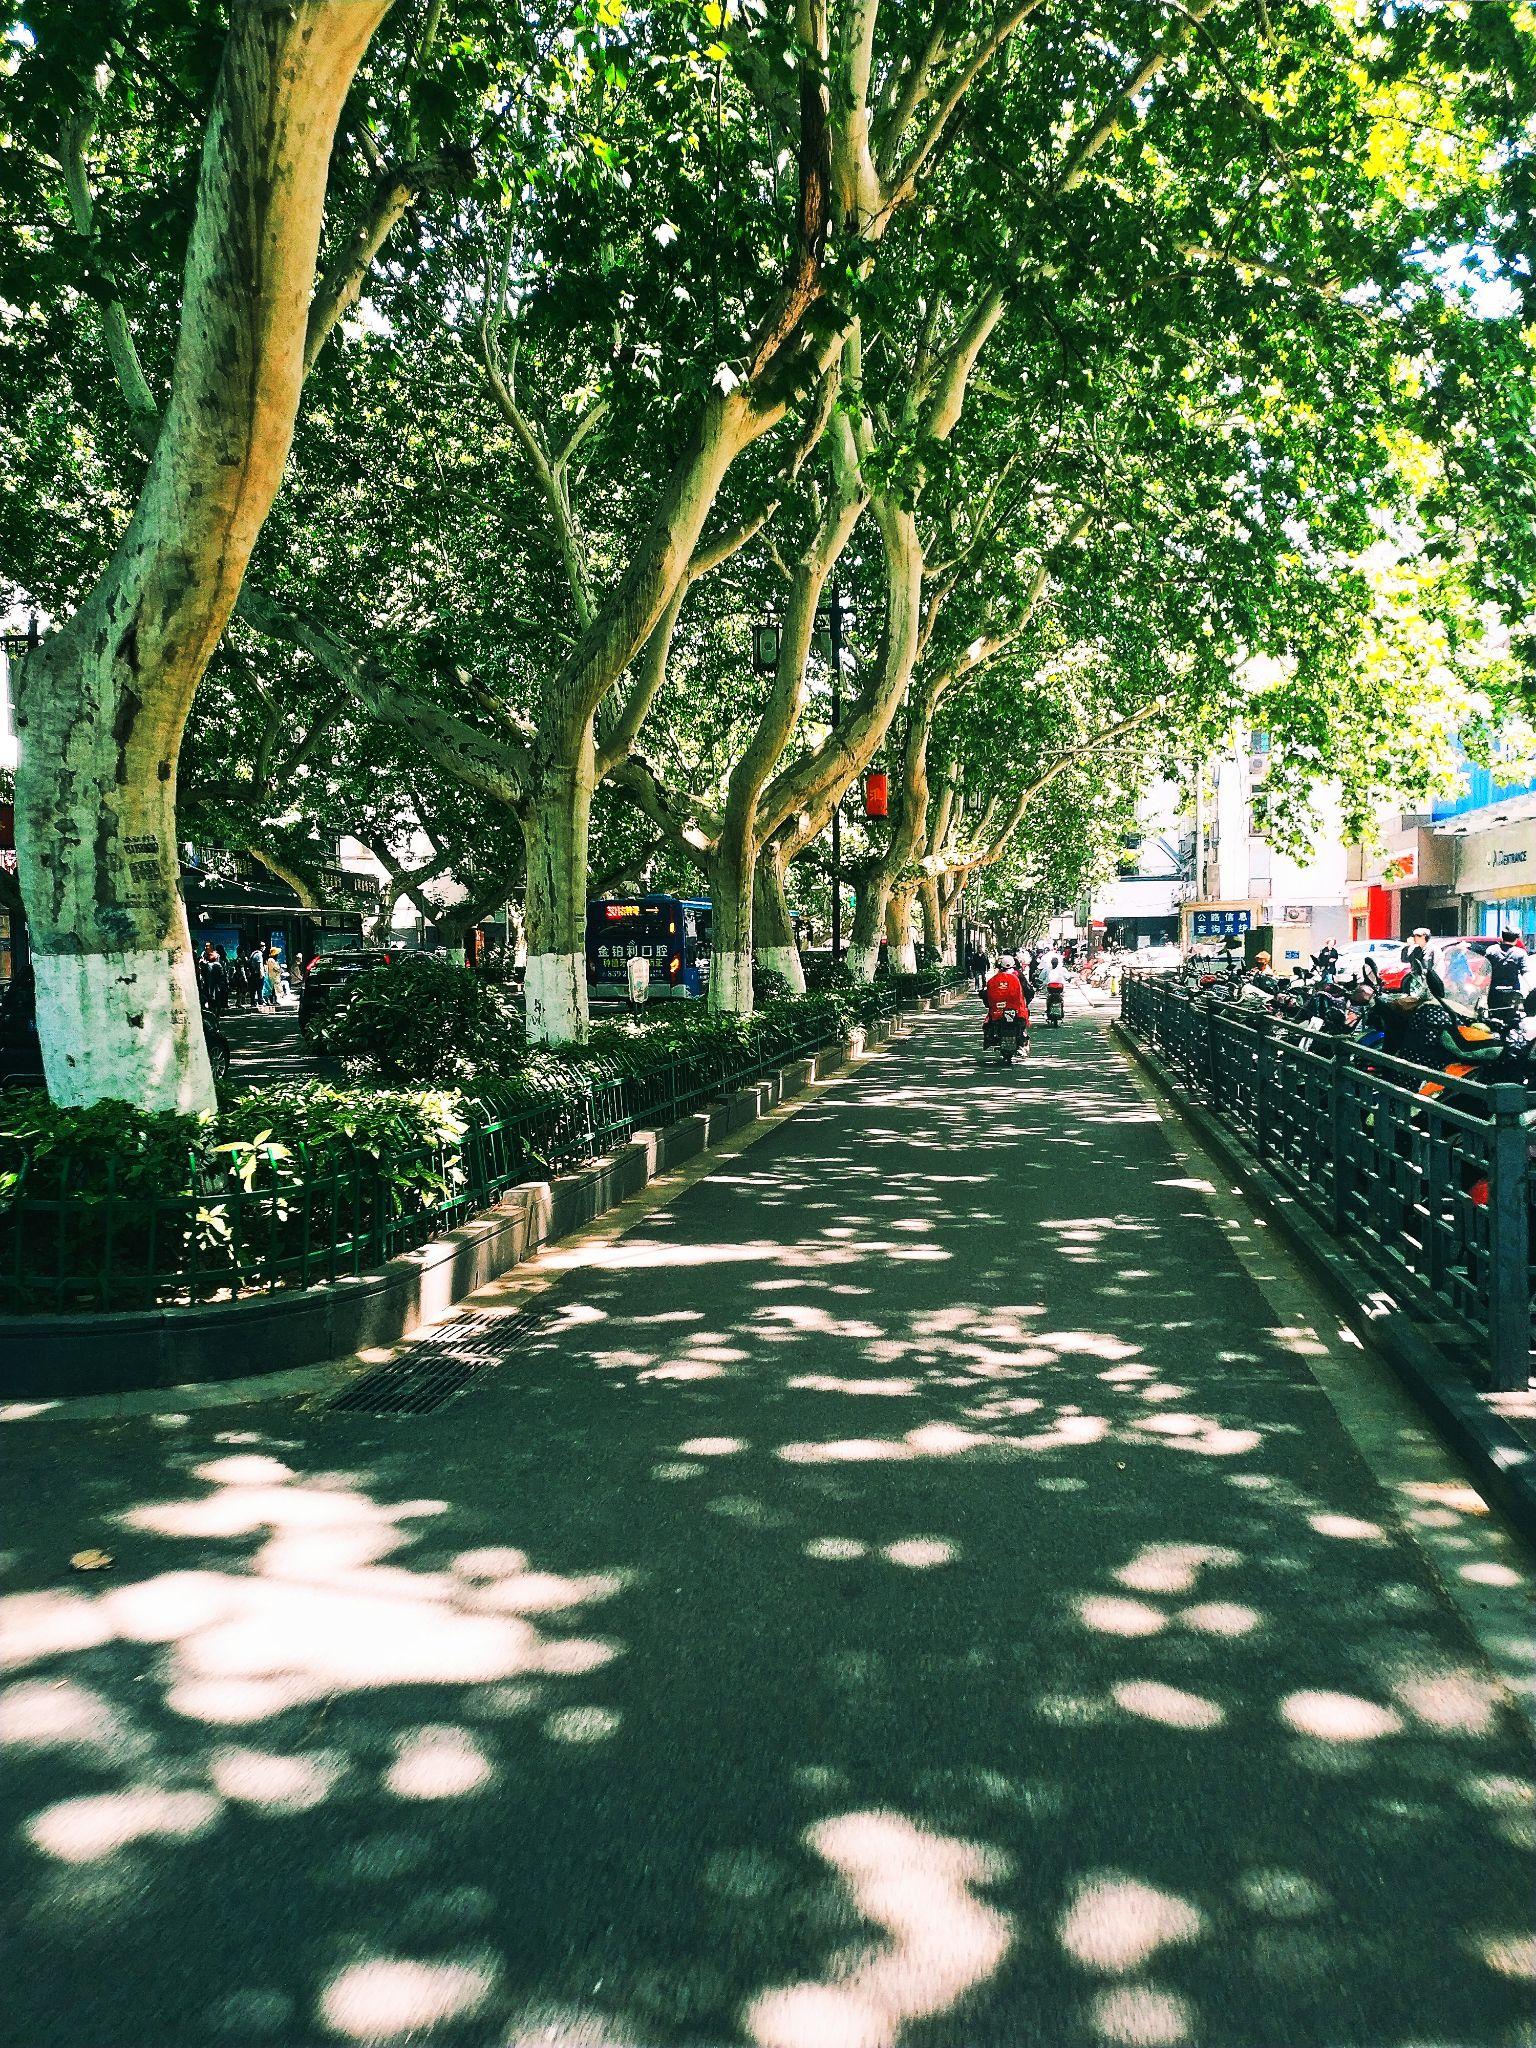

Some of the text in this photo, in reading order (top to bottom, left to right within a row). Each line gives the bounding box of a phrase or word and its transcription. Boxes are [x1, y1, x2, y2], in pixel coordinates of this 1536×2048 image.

[1197, 912, 1248, 922] 公路信息
[1197, 924, 1248, 934] 查询系统
[597, 945, 668, 957] 金铂利口腔
